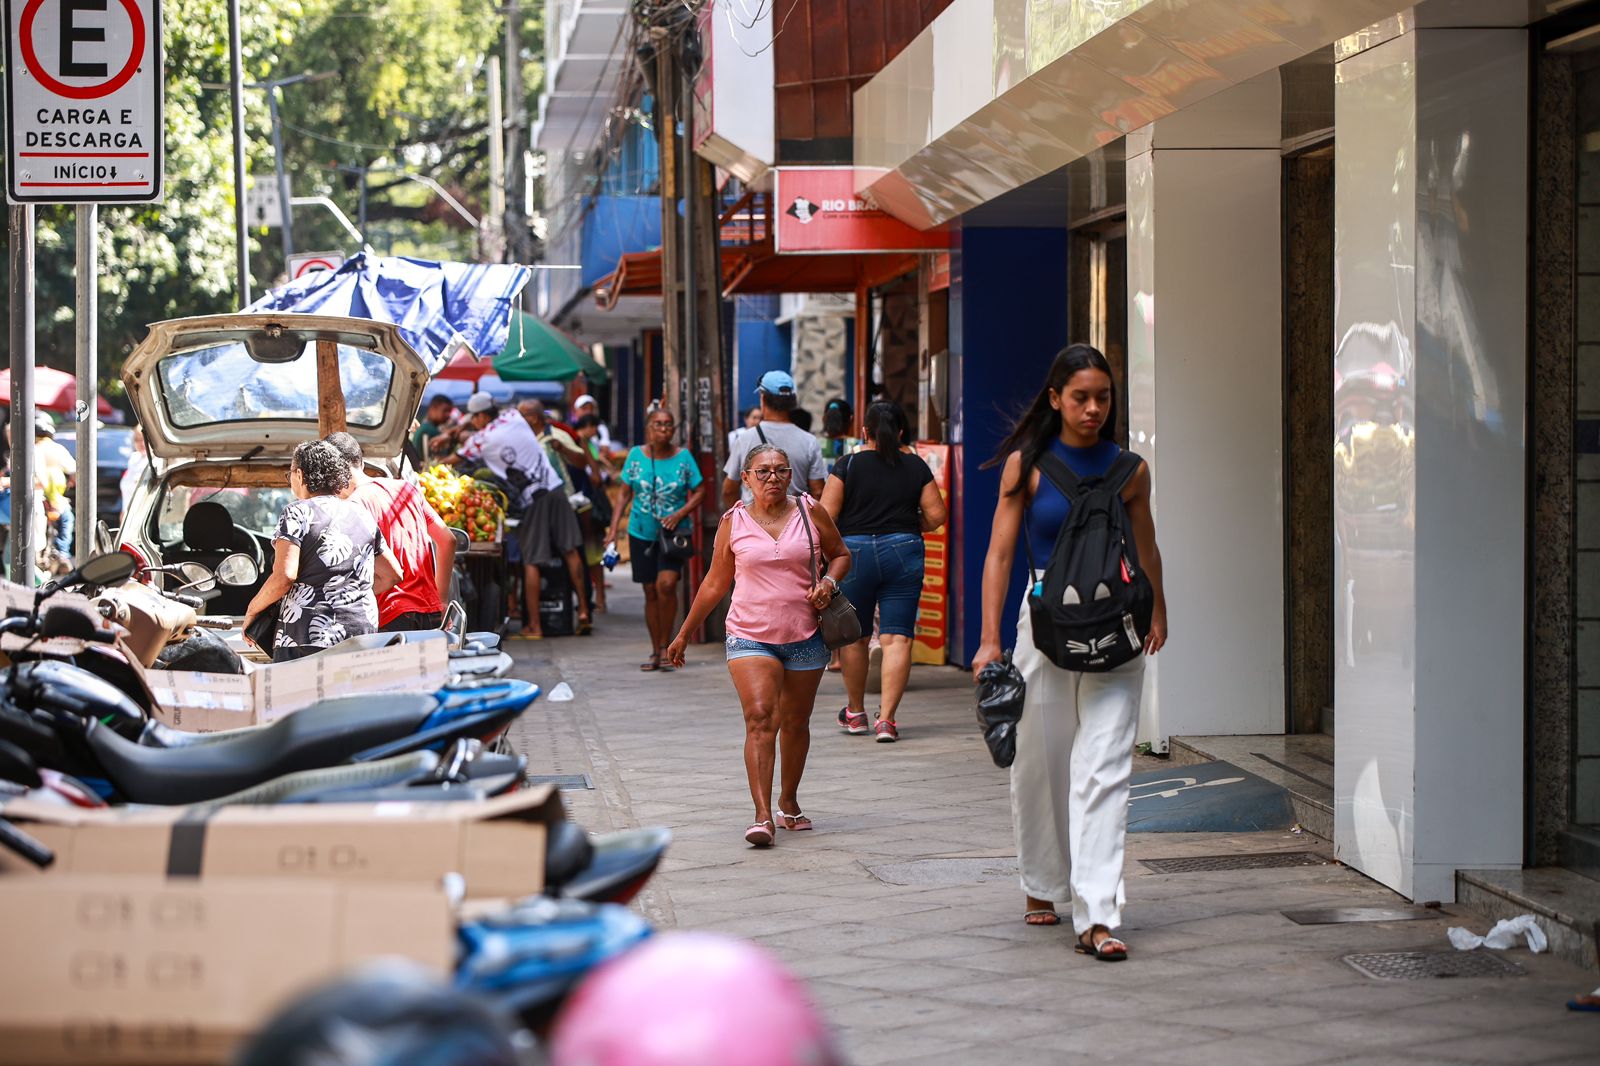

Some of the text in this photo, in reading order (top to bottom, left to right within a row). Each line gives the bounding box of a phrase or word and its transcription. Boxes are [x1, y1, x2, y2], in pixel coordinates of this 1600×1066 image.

[59, 0, 108, 77] E
[37, 108, 132, 125] CARGA E
[26, 131, 142, 148] DESCARGA
[54, 162, 107, 179] INÍCIO
[822, 199, 845, 211] RIO
